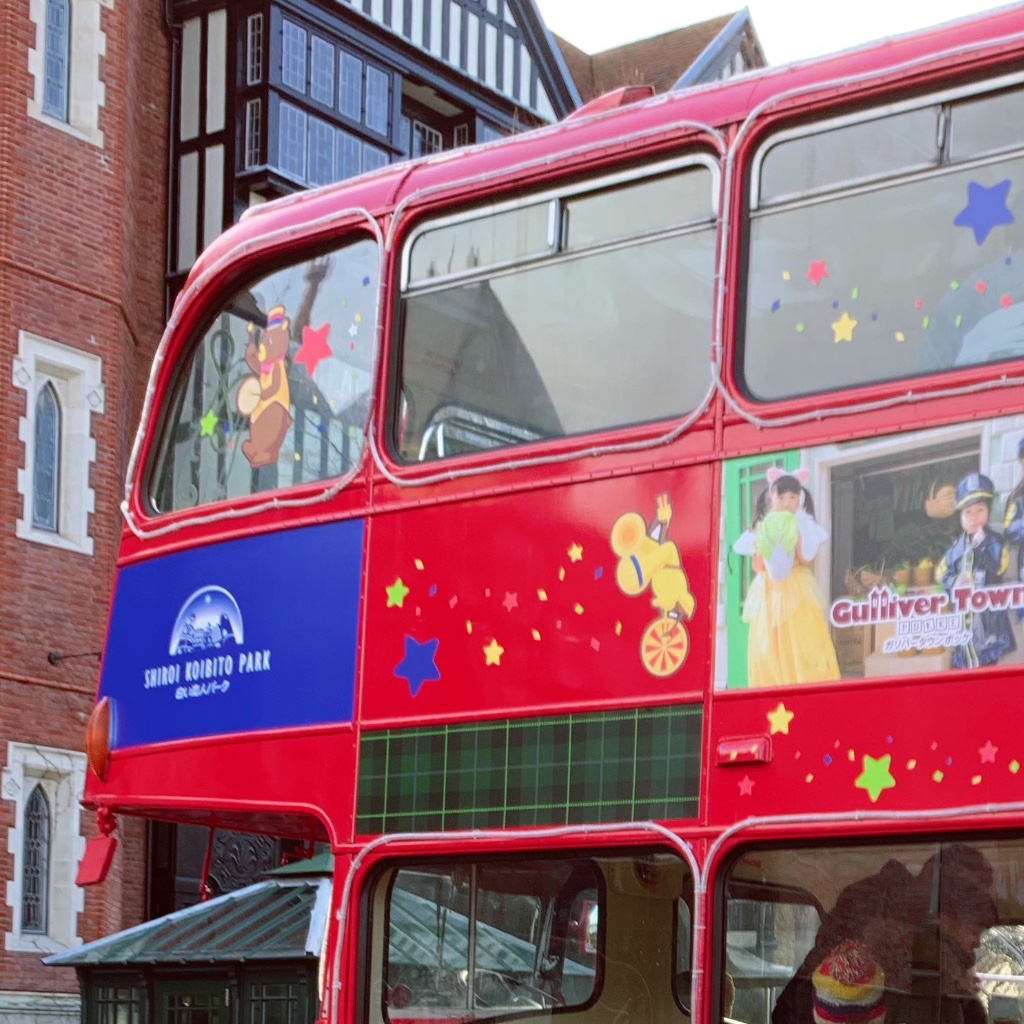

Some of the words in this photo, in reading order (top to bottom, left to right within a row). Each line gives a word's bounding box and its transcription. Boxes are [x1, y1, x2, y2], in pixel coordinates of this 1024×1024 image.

[832, 586, 948, 624] Gulliver
[144, 664, 180, 689] SHIROI
[185, 655, 233, 681] KOIBITO
[239, 649, 271, 673] PARK
